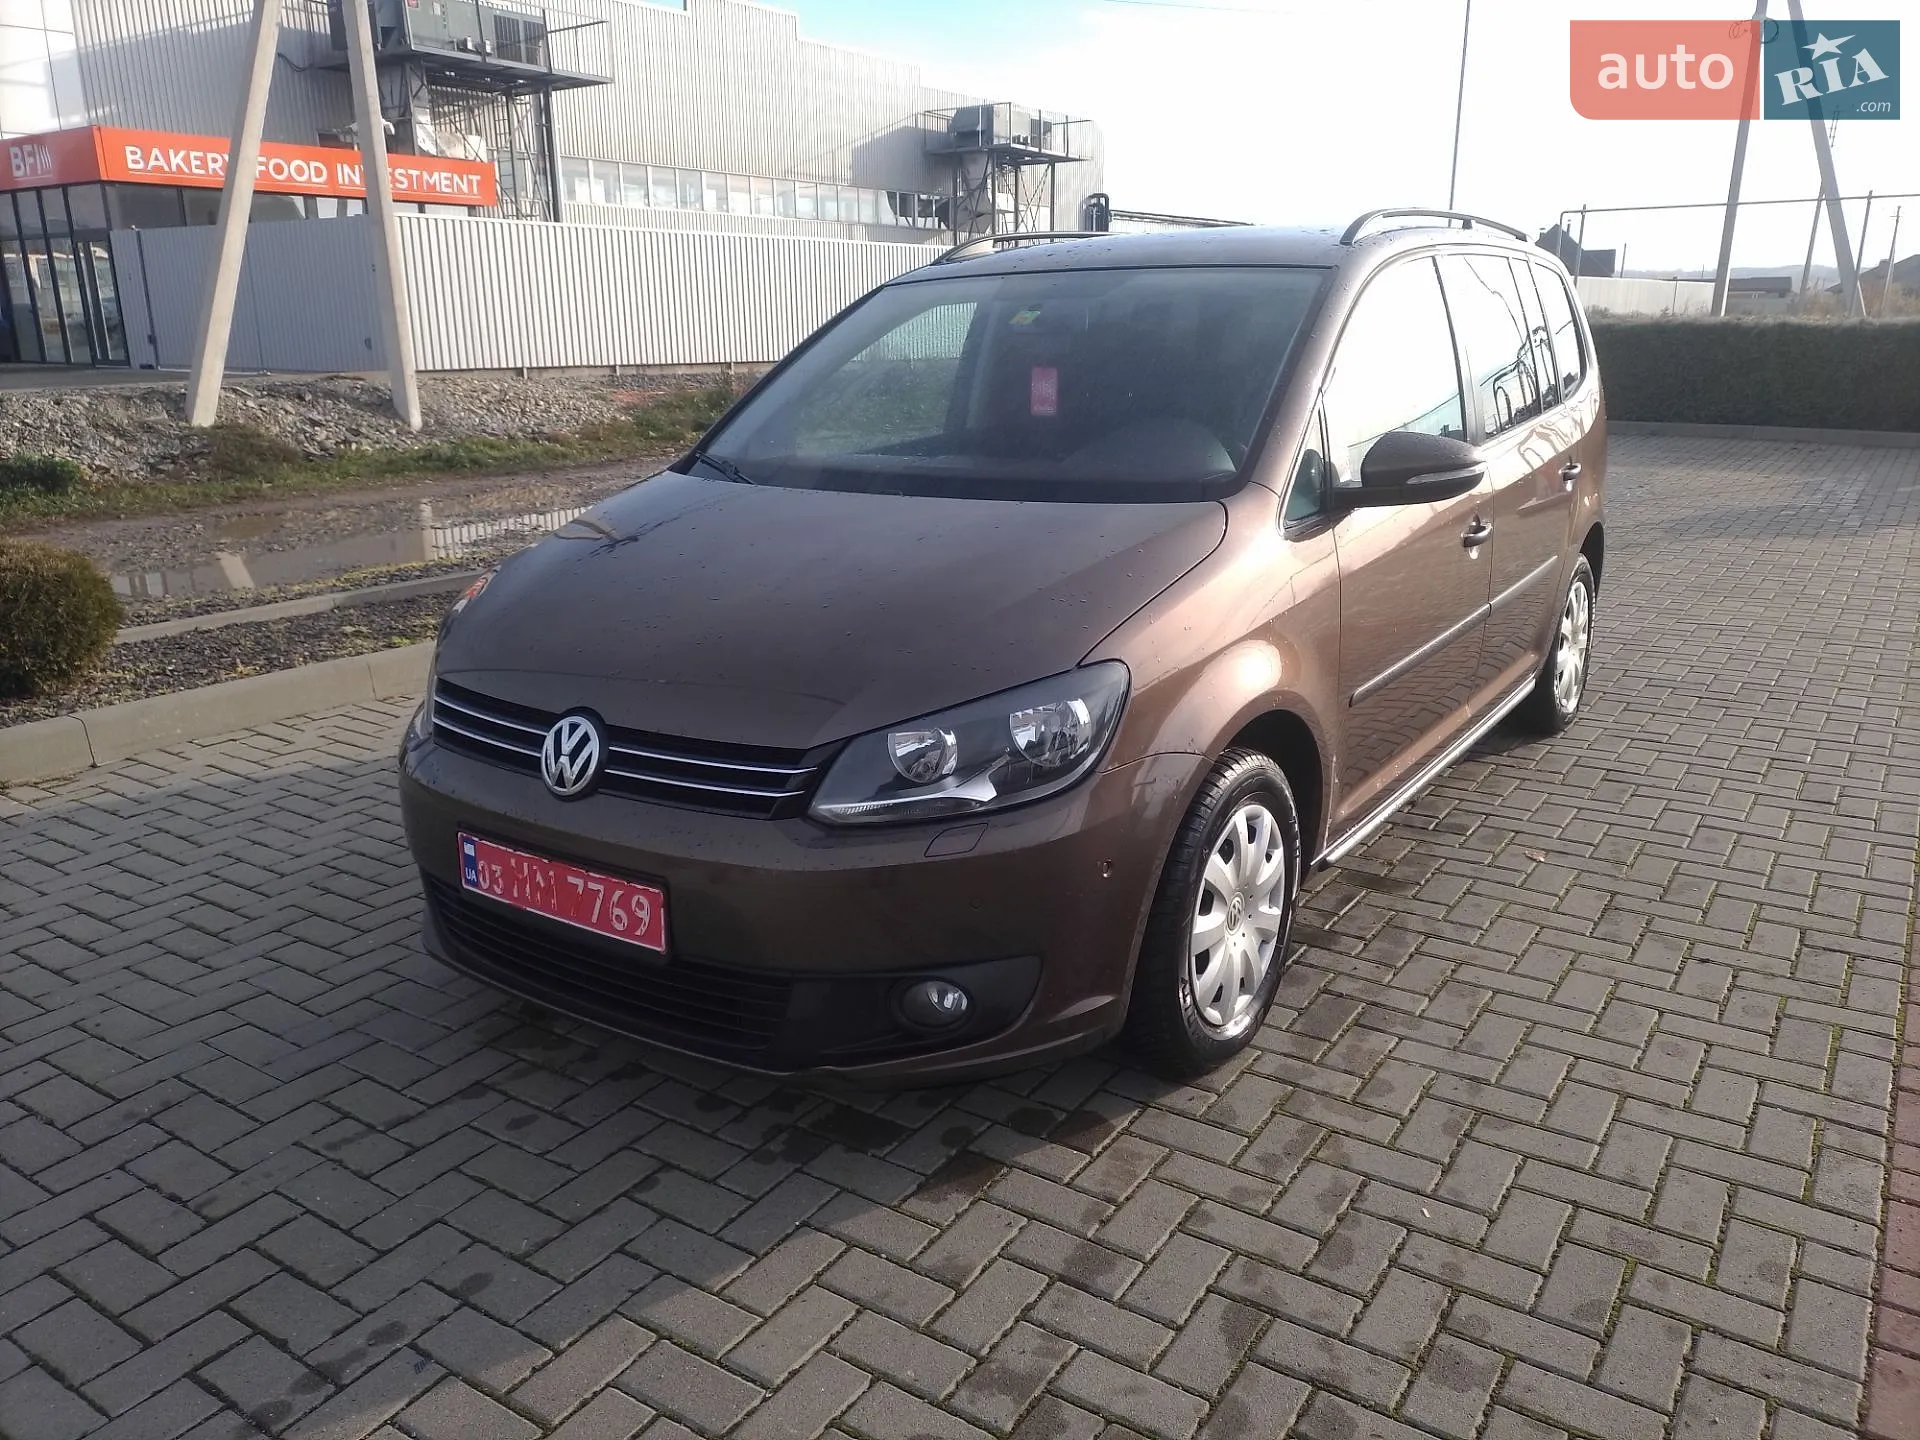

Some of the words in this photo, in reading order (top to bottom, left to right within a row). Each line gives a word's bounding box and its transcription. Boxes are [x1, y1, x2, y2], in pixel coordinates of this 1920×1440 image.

[124, 145, 230, 177] BAKER
[255, 156, 327, 183] FOOD
[336, 162, 481, 195] INSTMENT
[465, 867, 478, 883] UA
[478, 860, 504, 895] 03
[566, 875, 651, 936] 7769
